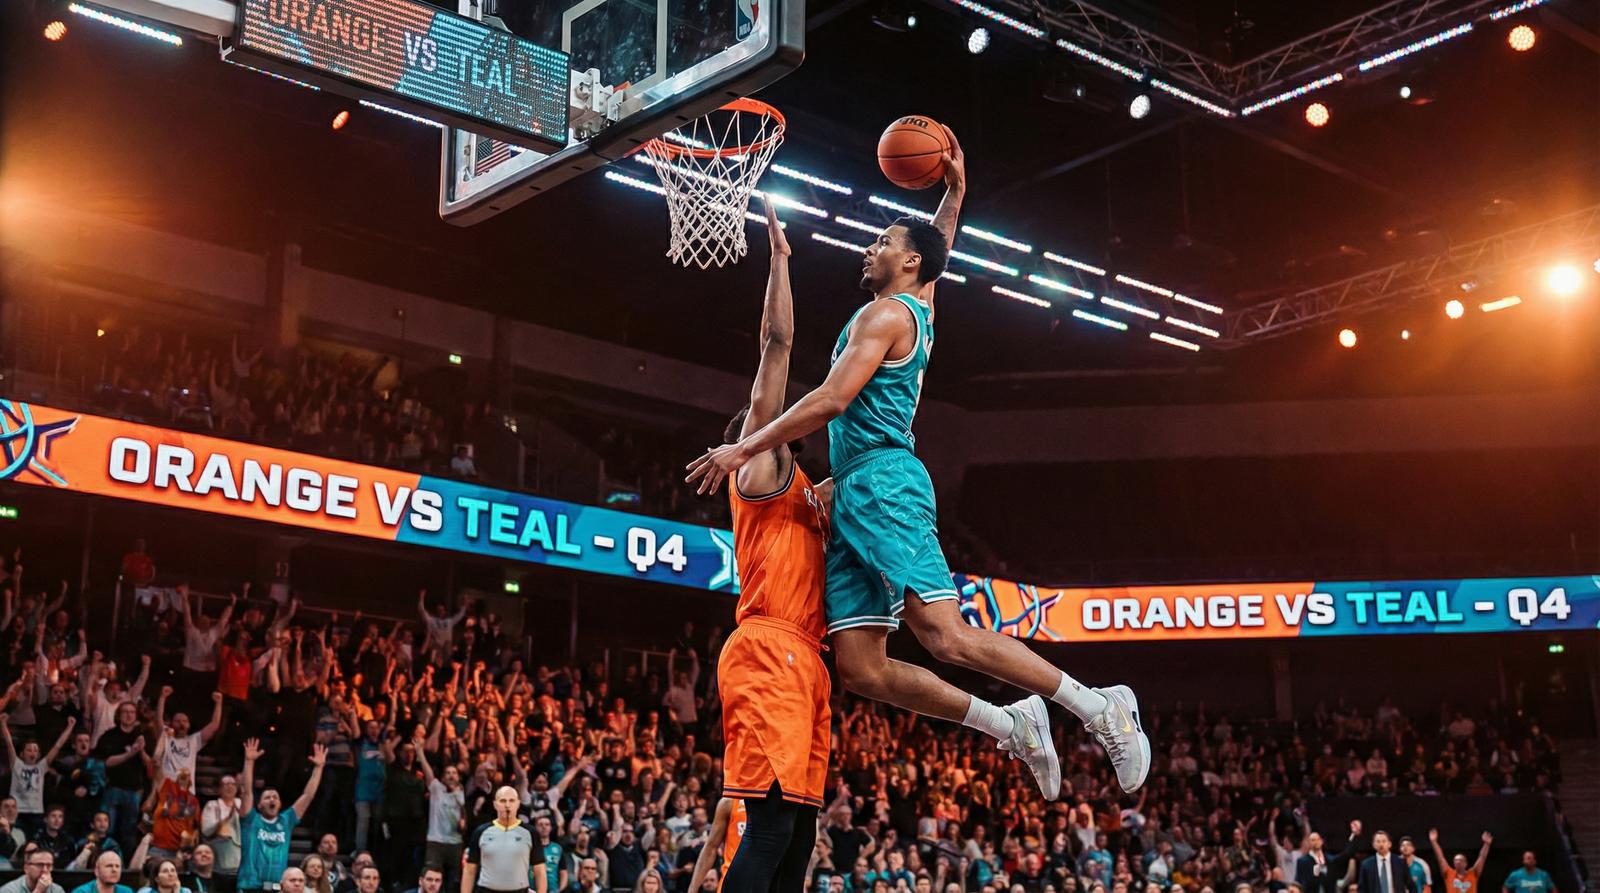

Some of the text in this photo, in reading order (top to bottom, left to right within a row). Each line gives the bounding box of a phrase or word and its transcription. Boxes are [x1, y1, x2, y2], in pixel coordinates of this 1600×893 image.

[268, 0, 518, 98] ORANGE VS TEAL
[109, 437, 687, 572] ORANGE VS TEAL - Q4
[1082, 588, 1571, 630] ORANGE VS TEAL - Q4
